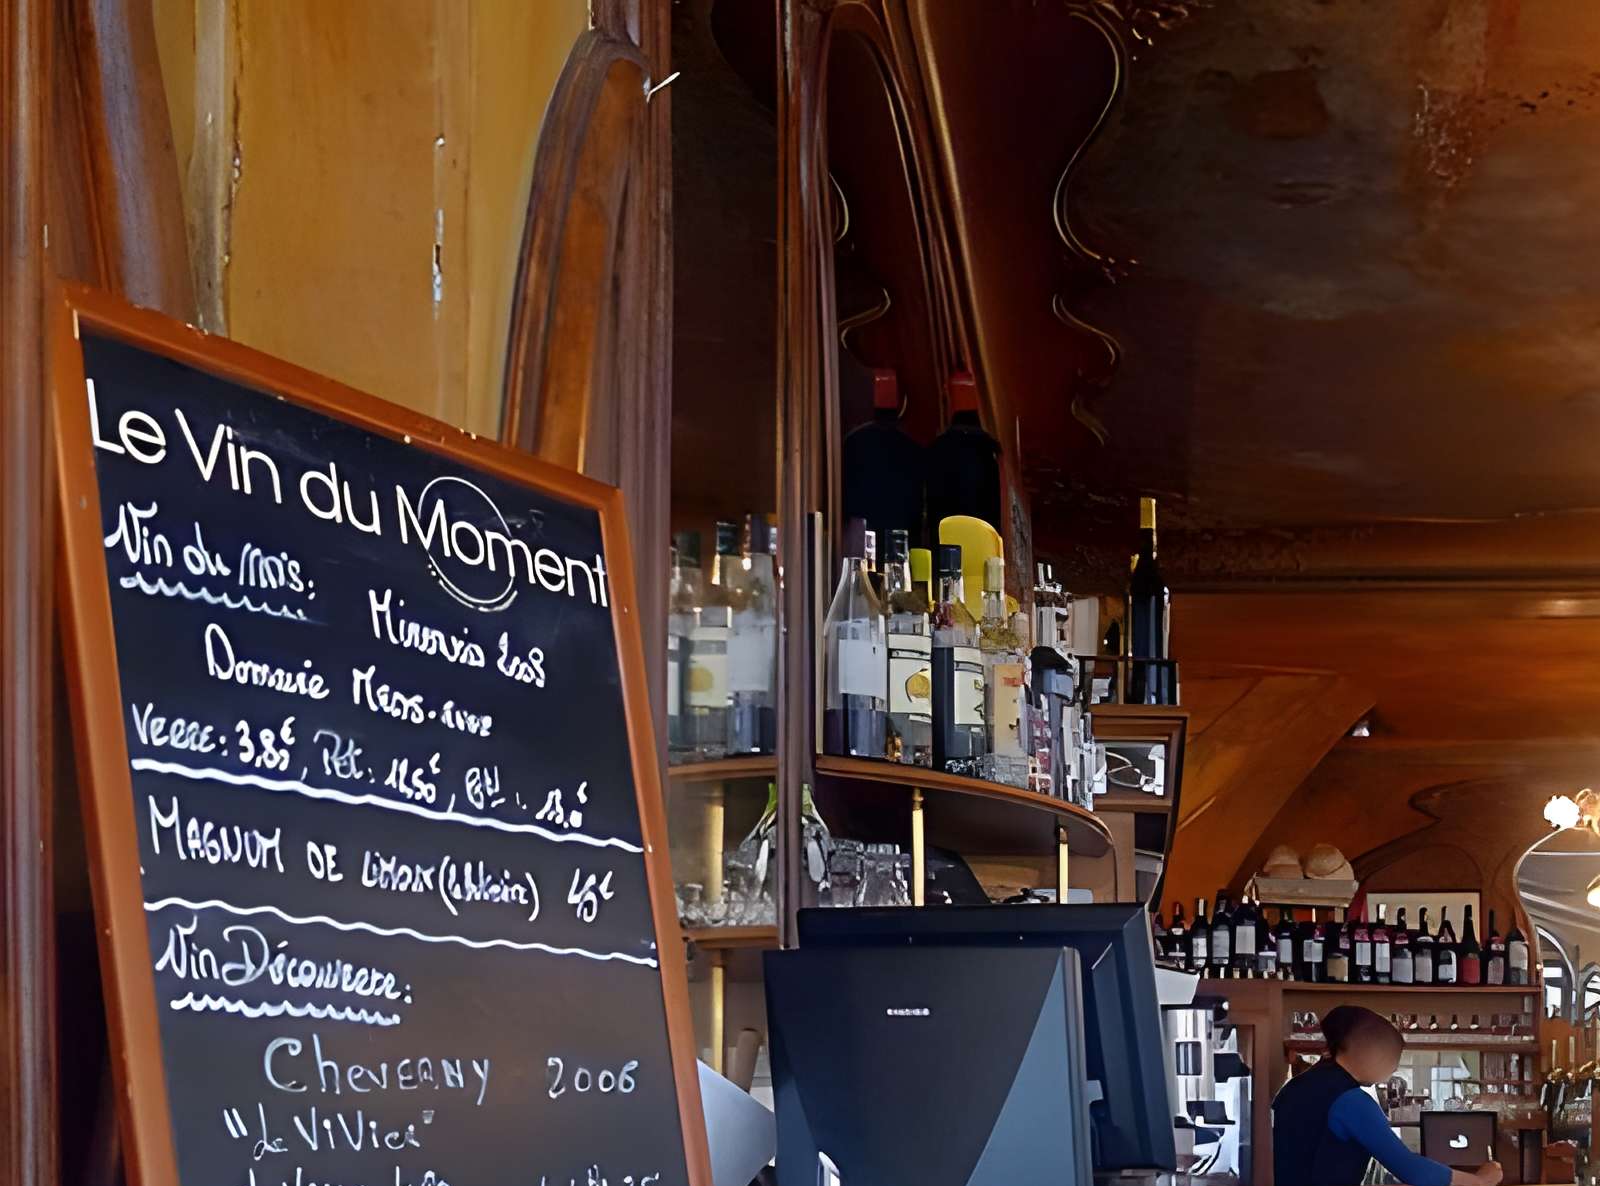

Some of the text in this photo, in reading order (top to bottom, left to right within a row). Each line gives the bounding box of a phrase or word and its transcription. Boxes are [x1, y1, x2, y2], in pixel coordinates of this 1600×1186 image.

[86, 378, 608, 607] Le Vin du Moment
[104, 501, 172, 567] Vin
[183, 521, 231, 576] du
[306, 840, 344, 883] DE
[155, 914, 220, 980] Vin
